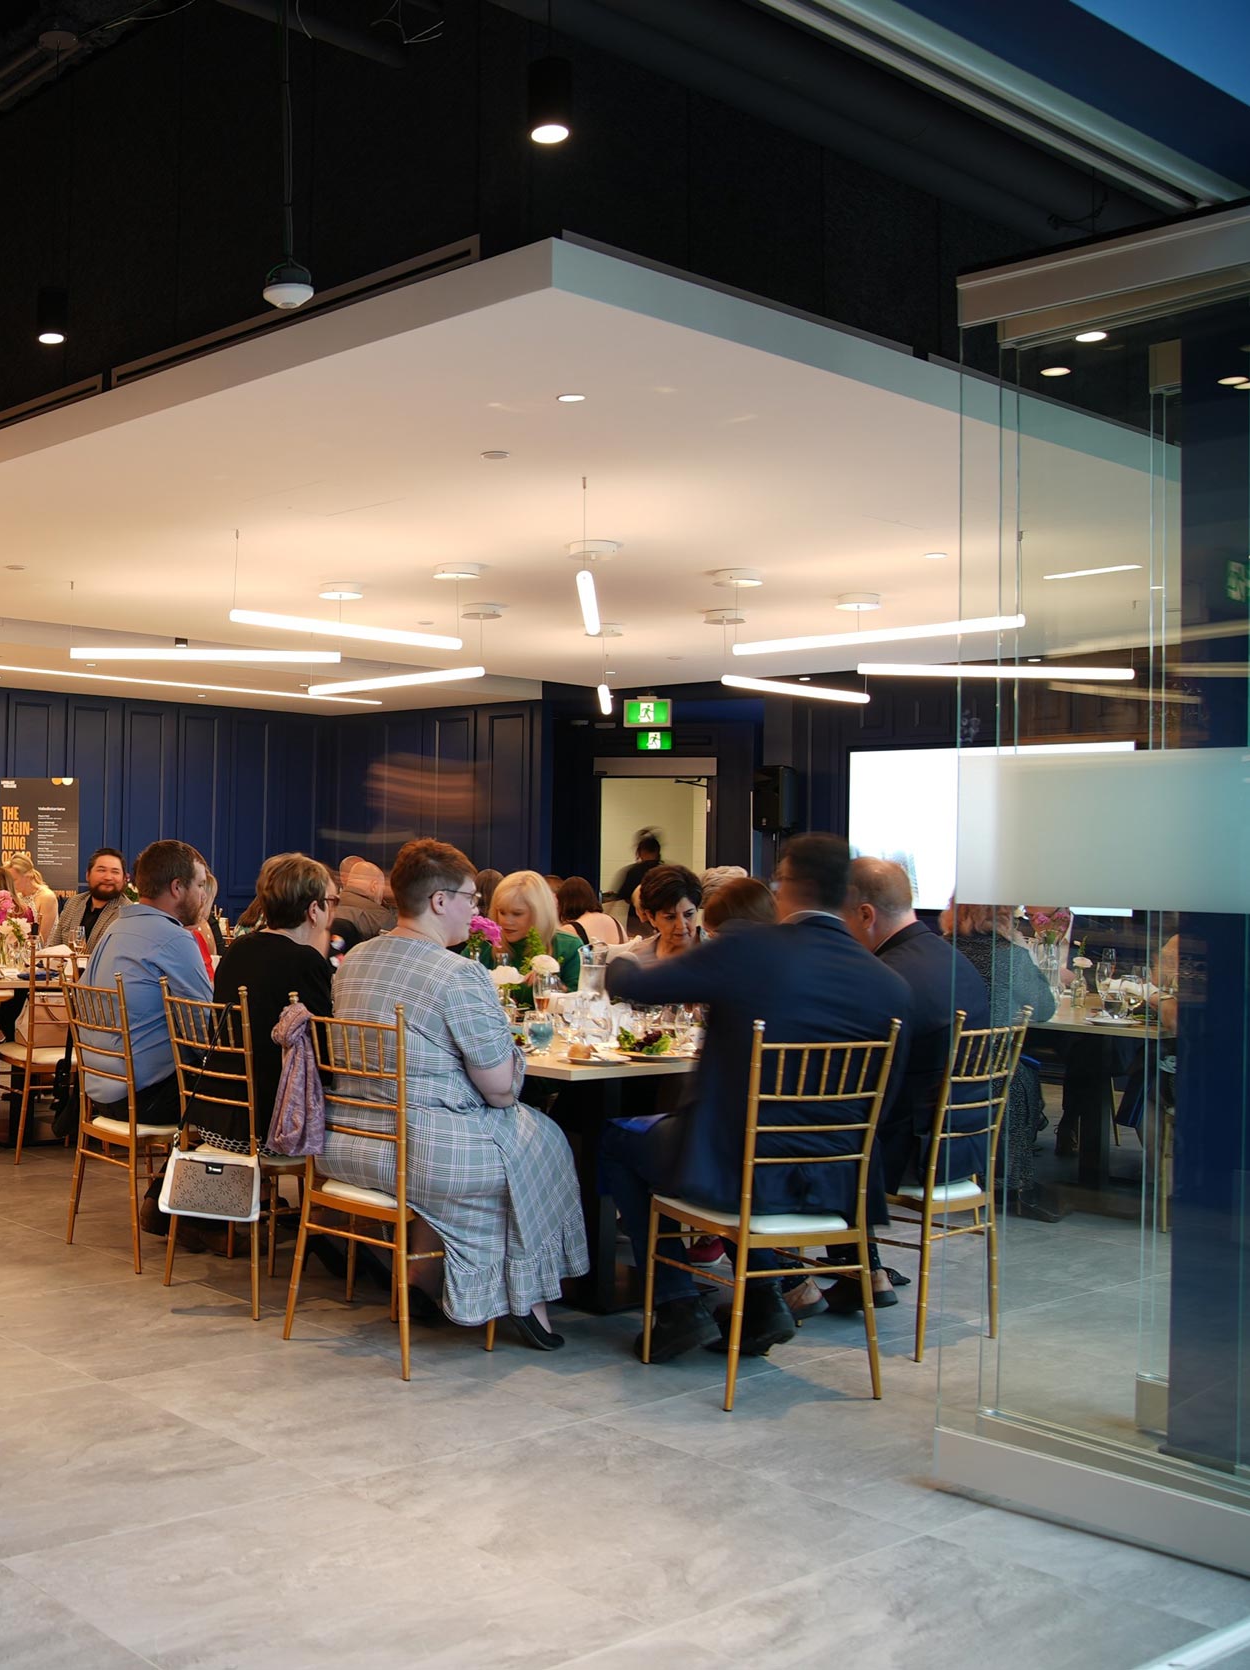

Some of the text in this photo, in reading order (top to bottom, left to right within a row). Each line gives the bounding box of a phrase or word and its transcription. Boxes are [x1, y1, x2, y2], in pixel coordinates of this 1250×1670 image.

[2, 806, 19, 820] THE
[2, 821, 34, 835] BEGIN-
[2, 836, 26, 850] NING
